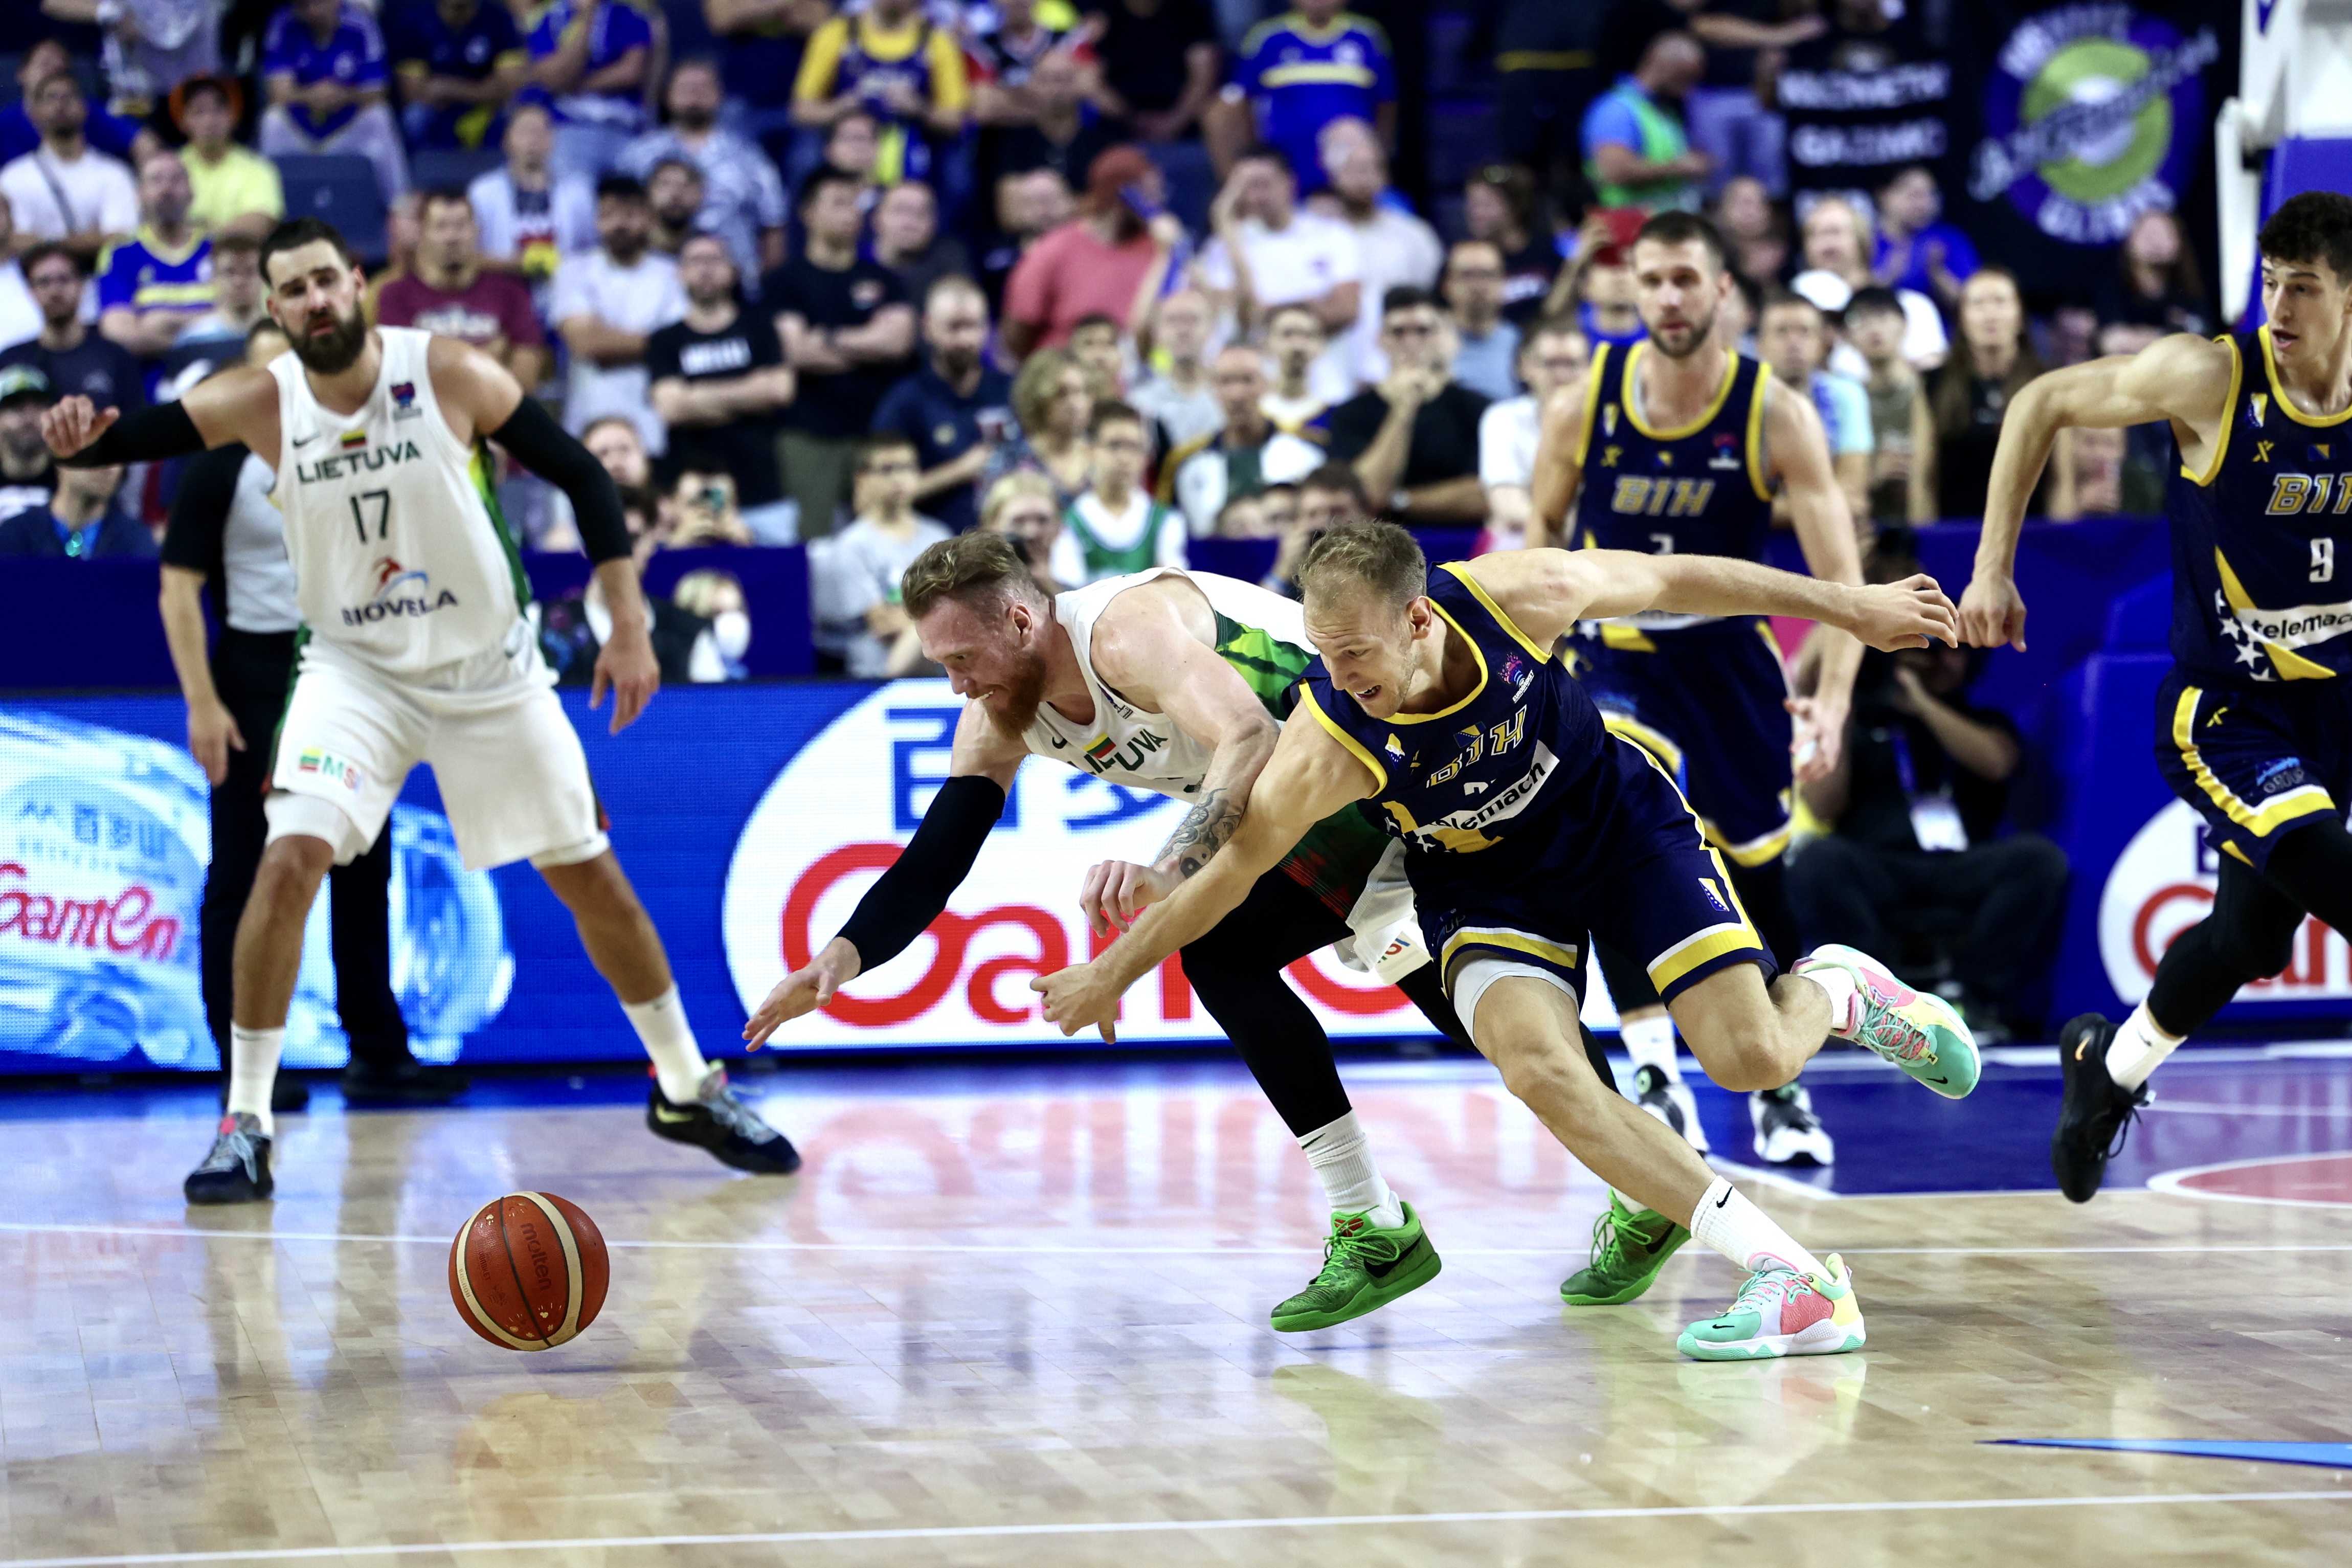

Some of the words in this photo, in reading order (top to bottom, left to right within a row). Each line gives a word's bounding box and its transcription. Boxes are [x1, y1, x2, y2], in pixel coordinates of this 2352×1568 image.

[297, 441, 421, 484] LIETUVA
[350, 488, 391, 544] 17
[1611, 474, 1715, 517] BIH
[2309, 537, 2334, 583] 9
[2252, 613, 2352, 639] telemac
[520, 1223, 552, 1291] molten
